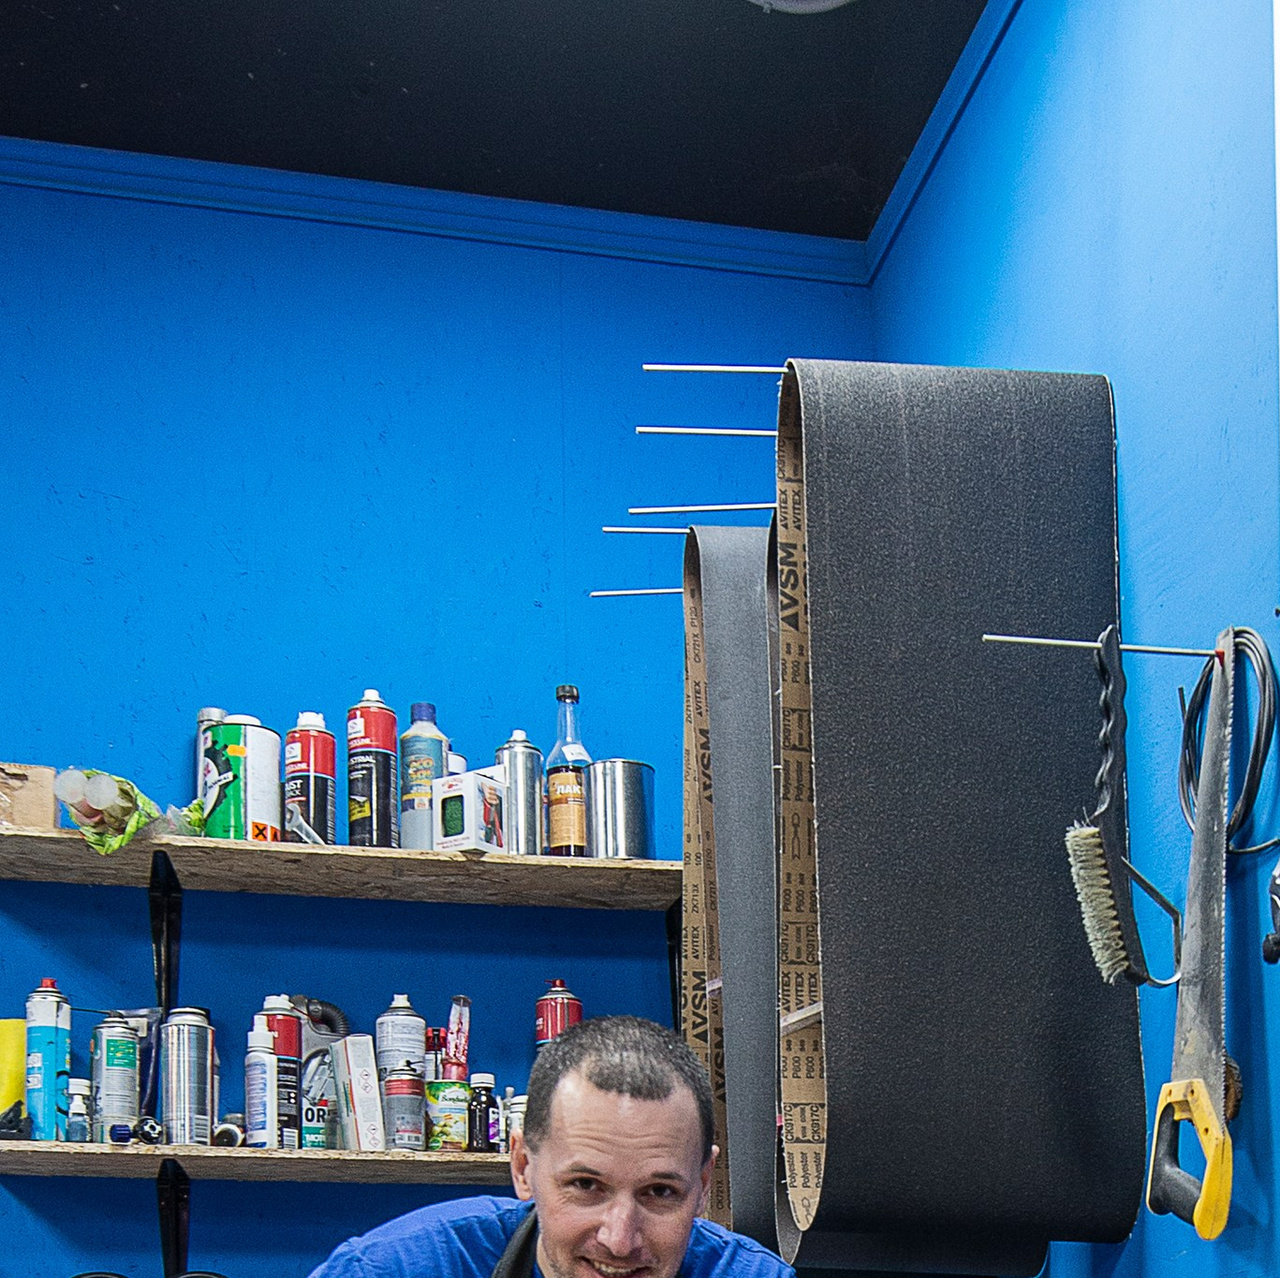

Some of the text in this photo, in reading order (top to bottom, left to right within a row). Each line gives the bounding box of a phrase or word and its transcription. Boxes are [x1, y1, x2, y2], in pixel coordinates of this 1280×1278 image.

[785, 1105, 793, 1141] CK917C
[811, 1105, 820, 1141] CK917C
[800, 1152, 810, 1188] Polyester
